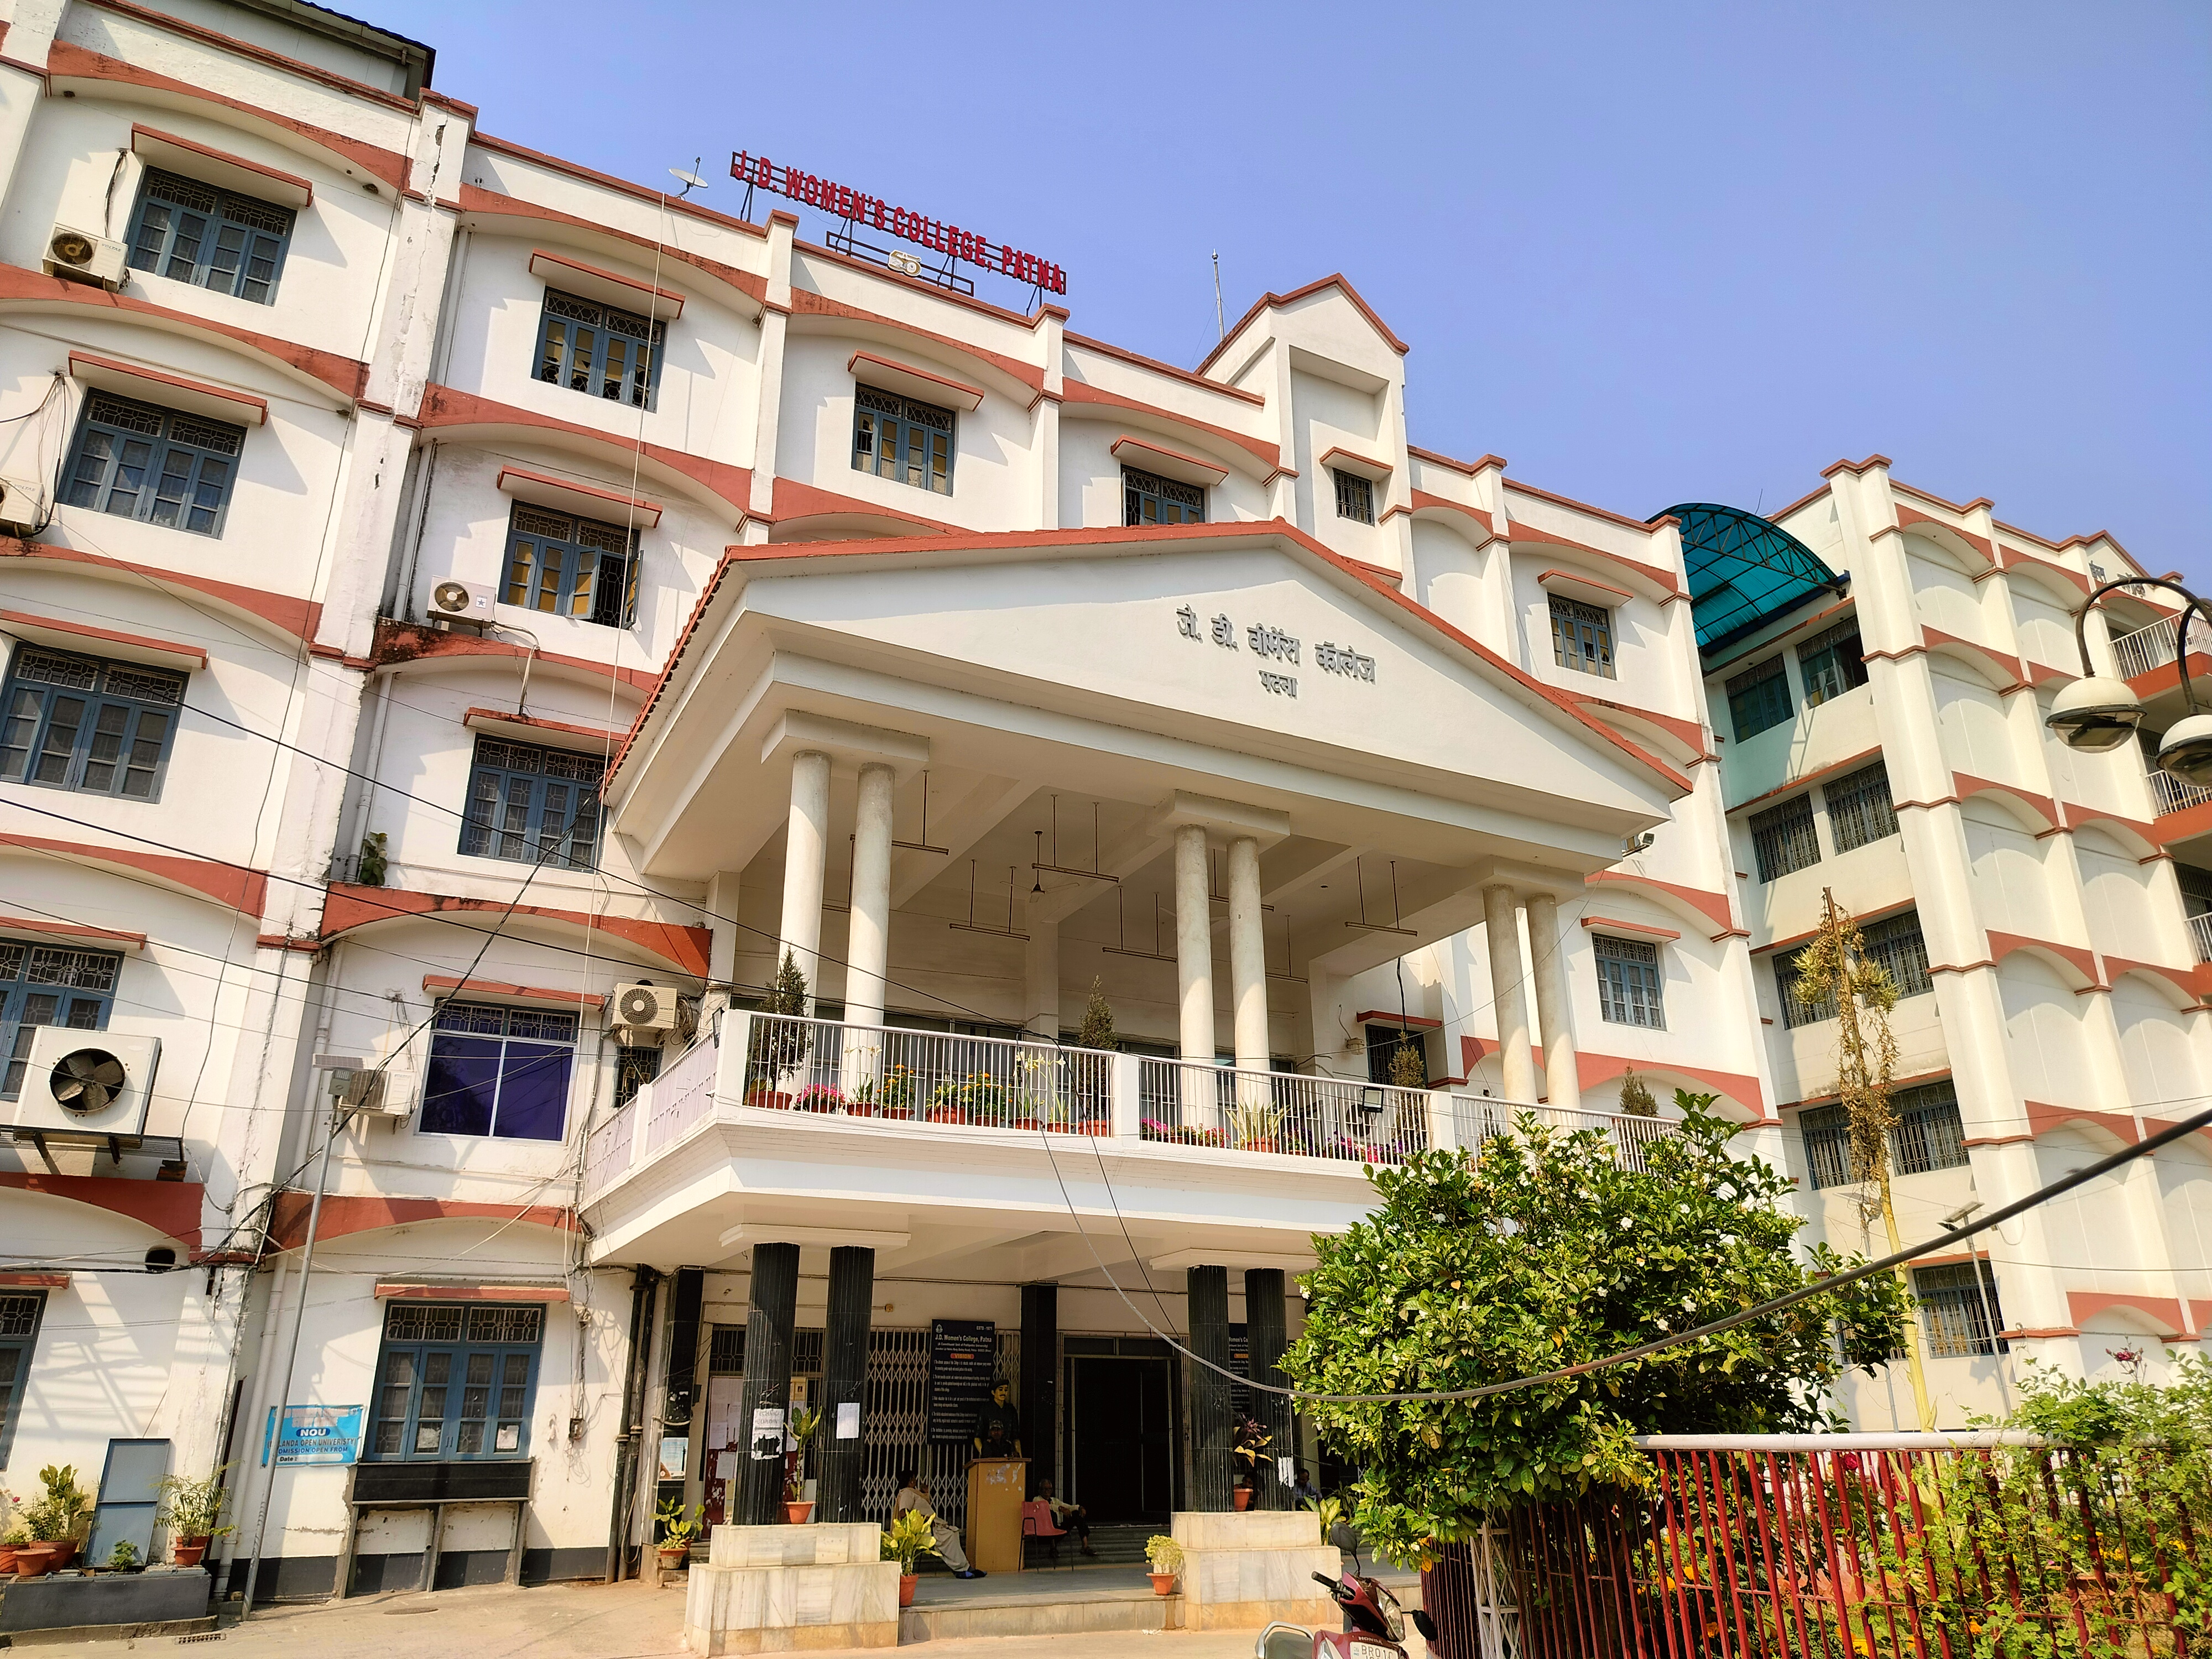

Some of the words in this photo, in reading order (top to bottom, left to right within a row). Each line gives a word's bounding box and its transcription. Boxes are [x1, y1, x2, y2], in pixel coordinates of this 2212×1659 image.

[786, 167, 885, 229] WOMEN'S
[893, 207, 992, 272] COLLEGE,
[1002, 246, 1064, 294] PATNA
[102, 243, 122, 252] VOLTAS
[1211, 613, 1237, 648] डी.
[1314, 640, 1375, 681] कॉलेज
[1258, 670, 1297, 697] पटना
[1358, 1636, 1383, 1645] HONDA
